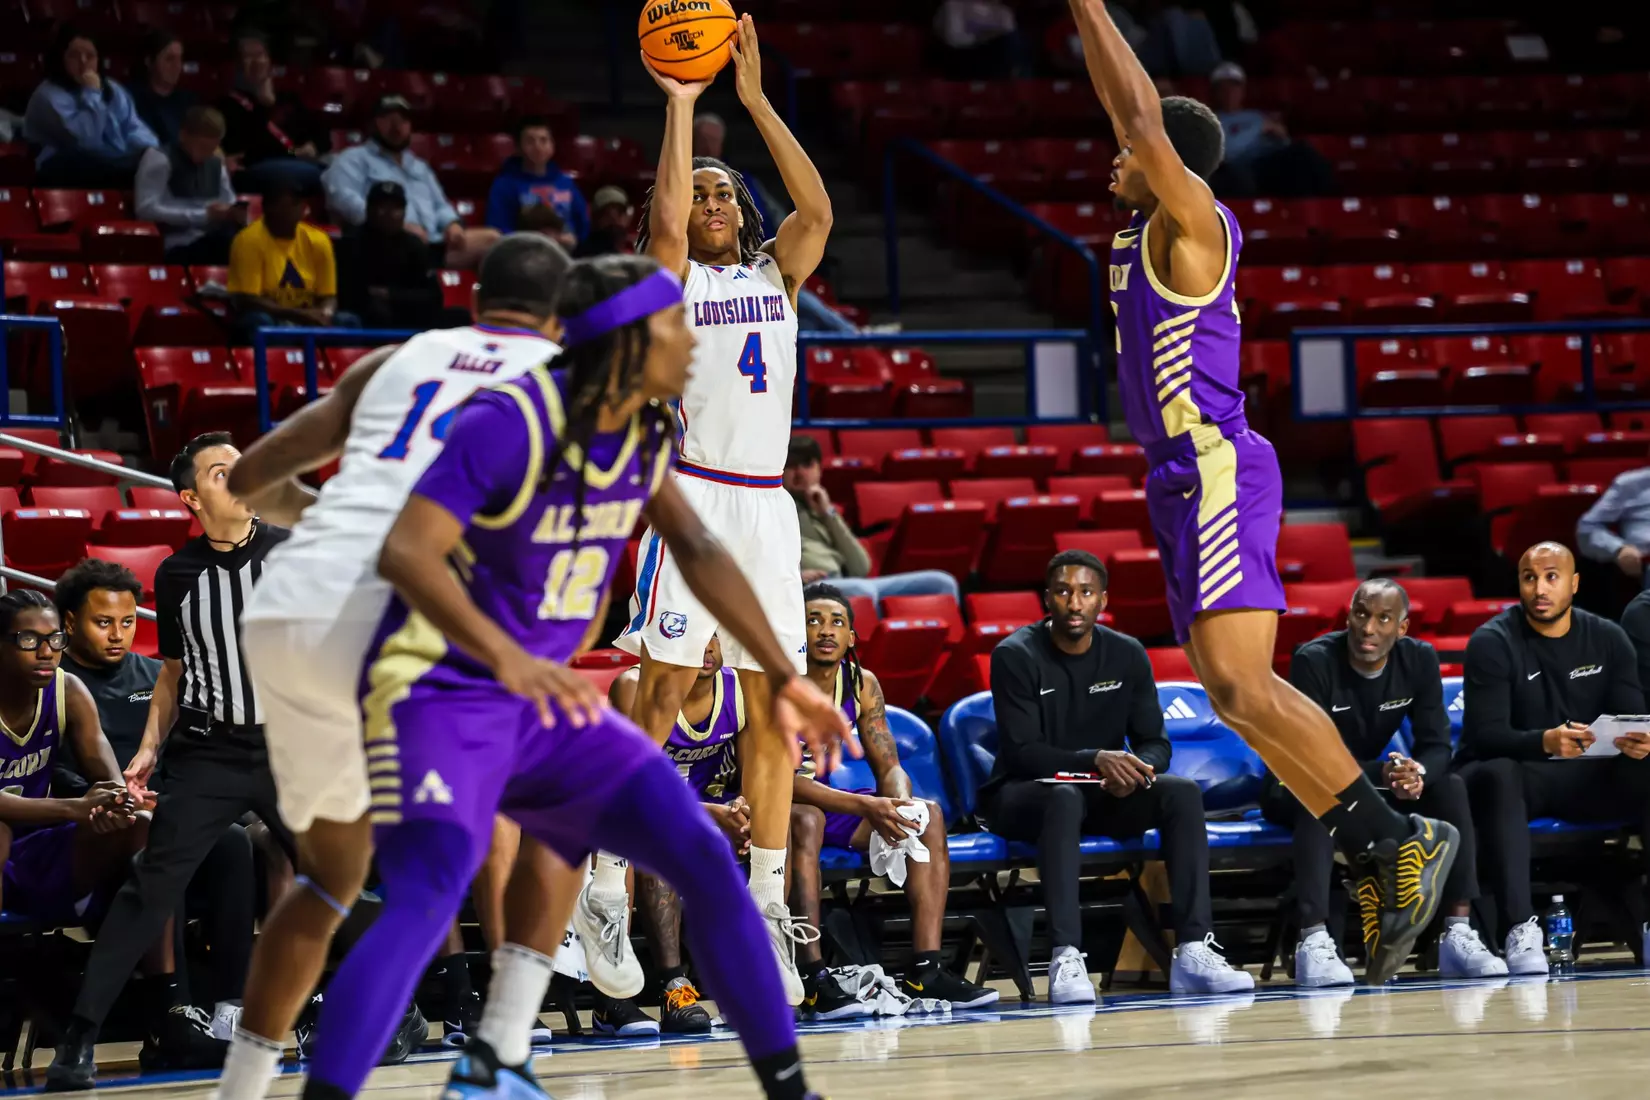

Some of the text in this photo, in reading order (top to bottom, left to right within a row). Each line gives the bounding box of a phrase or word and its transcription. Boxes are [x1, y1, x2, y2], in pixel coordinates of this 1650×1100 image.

[647, 0, 712, 24] Wilson
[694, 294, 785, 327] LOUISIANA TECH
[737, 332, 768, 394] 4
[537, 546, 610, 620] 12
